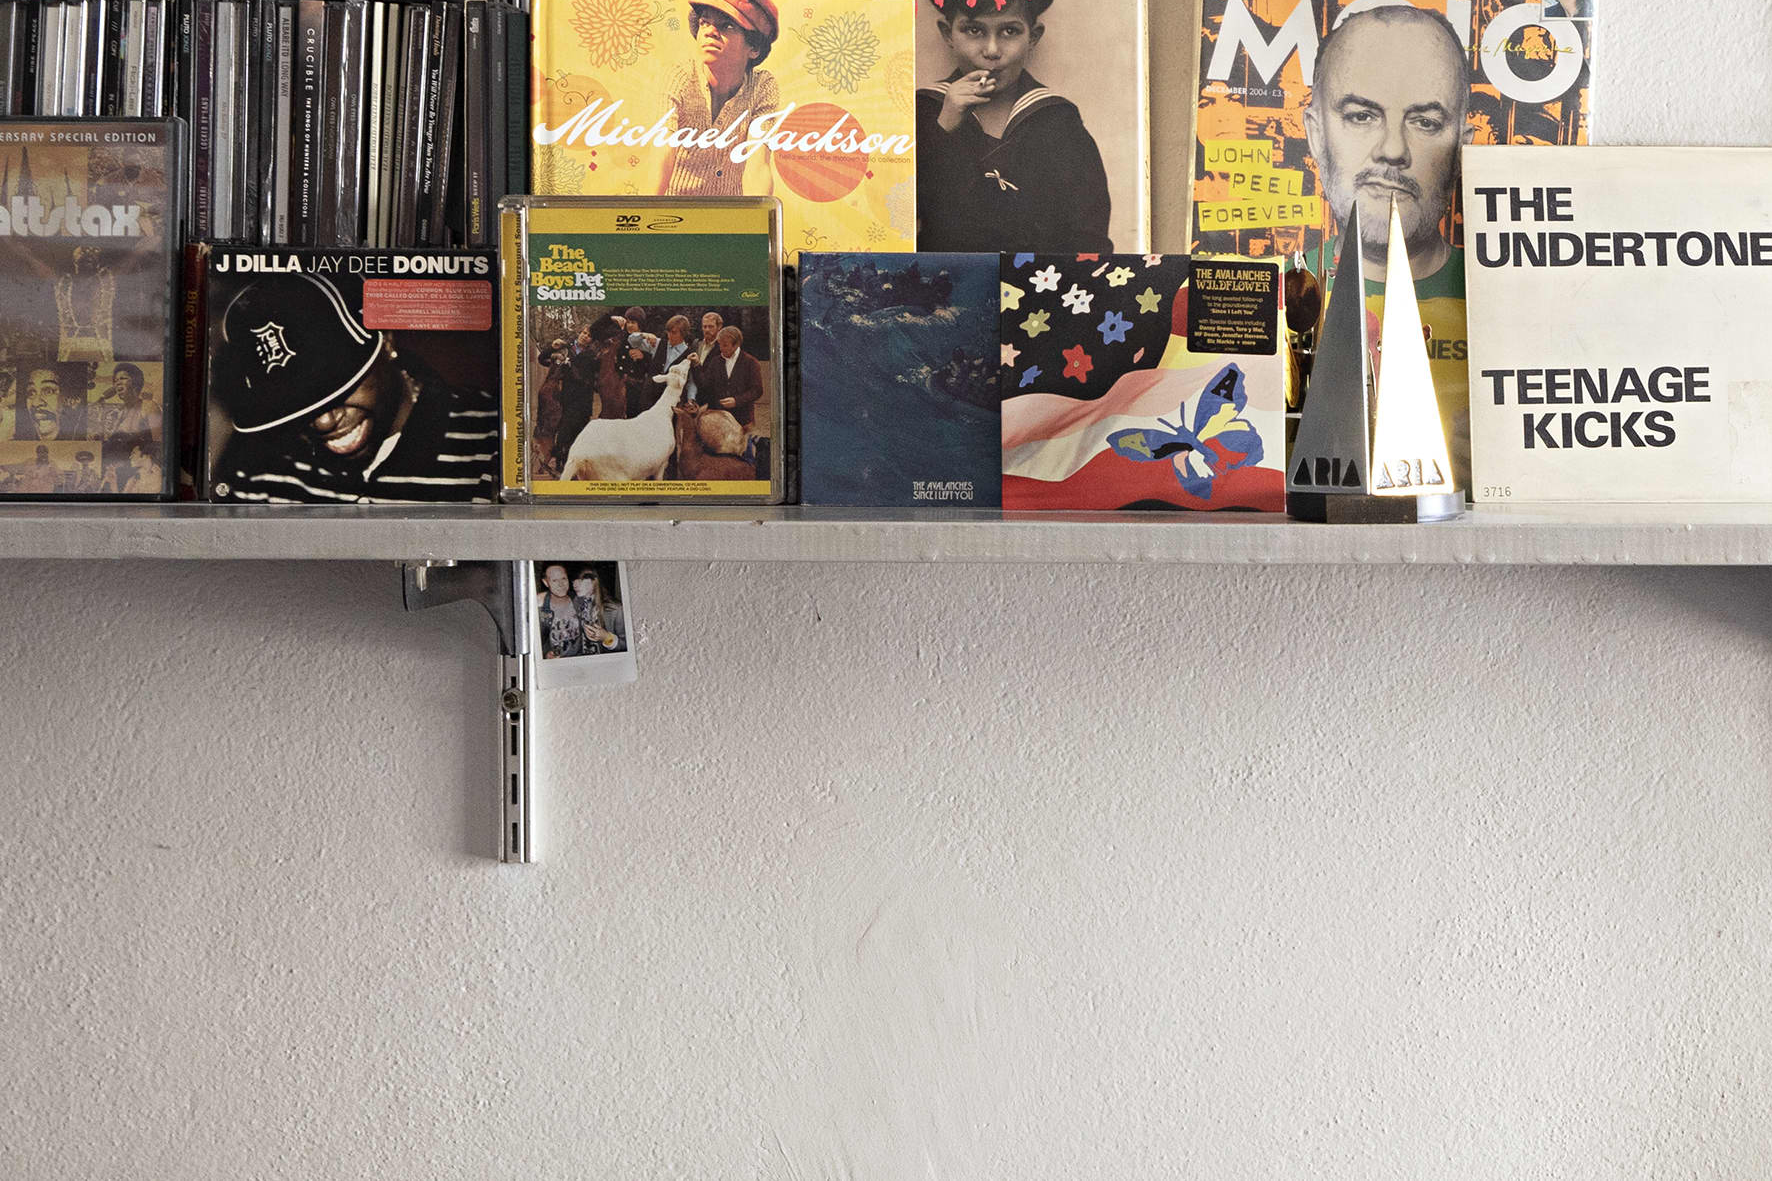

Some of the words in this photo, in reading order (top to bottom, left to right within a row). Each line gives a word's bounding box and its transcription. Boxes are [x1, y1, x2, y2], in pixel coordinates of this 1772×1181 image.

[304, 28, 315, 91] CRUCIBLE
[303, 110, 311, 132] SONGS
[533, 97, 740, 149] Michael
[730, 102, 916, 164] Jackson
[50, 132, 98, 142] SPECIAL
[104, 132, 156, 143] EDITION
[303, 133, 310, 142] OF
[1208, 144, 1272, 166] JOHN
[1232, 172, 1301, 196] PEEL
[1202, 203, 1315, 224] FOREVER!
[1474, 186, 1574, 222] THE
[548, 244, 585, 260] The
[216, 256, 231, 273] J
[236, 255, 302, 273] DILLA
[307, 256, 343, 274] JAY
[349, 256, 388, 274] DEE
[393, 256, 489, 274] DONUTS
[539, 258, 596, 273] Beach
[1196, 268, 1214, 280] THE
[1215, 269, 1271, 281] AVALANCHES
[530, 272, 575, 290] Boys
[574, 272, 604, 287] Pet
[1195, 279, 1271, 292] WILDFLOWER
[536, 286, 606, 301] Sounds
[1481, 366, 1711, 405] TEENAGE
[1523, 410, 1676, 449] KICKS
[1292, 457, 1362, 488] ARIA
[1376, 458, 1445, 490] ARIA
[1483, 486, 1512, 498] 3716
